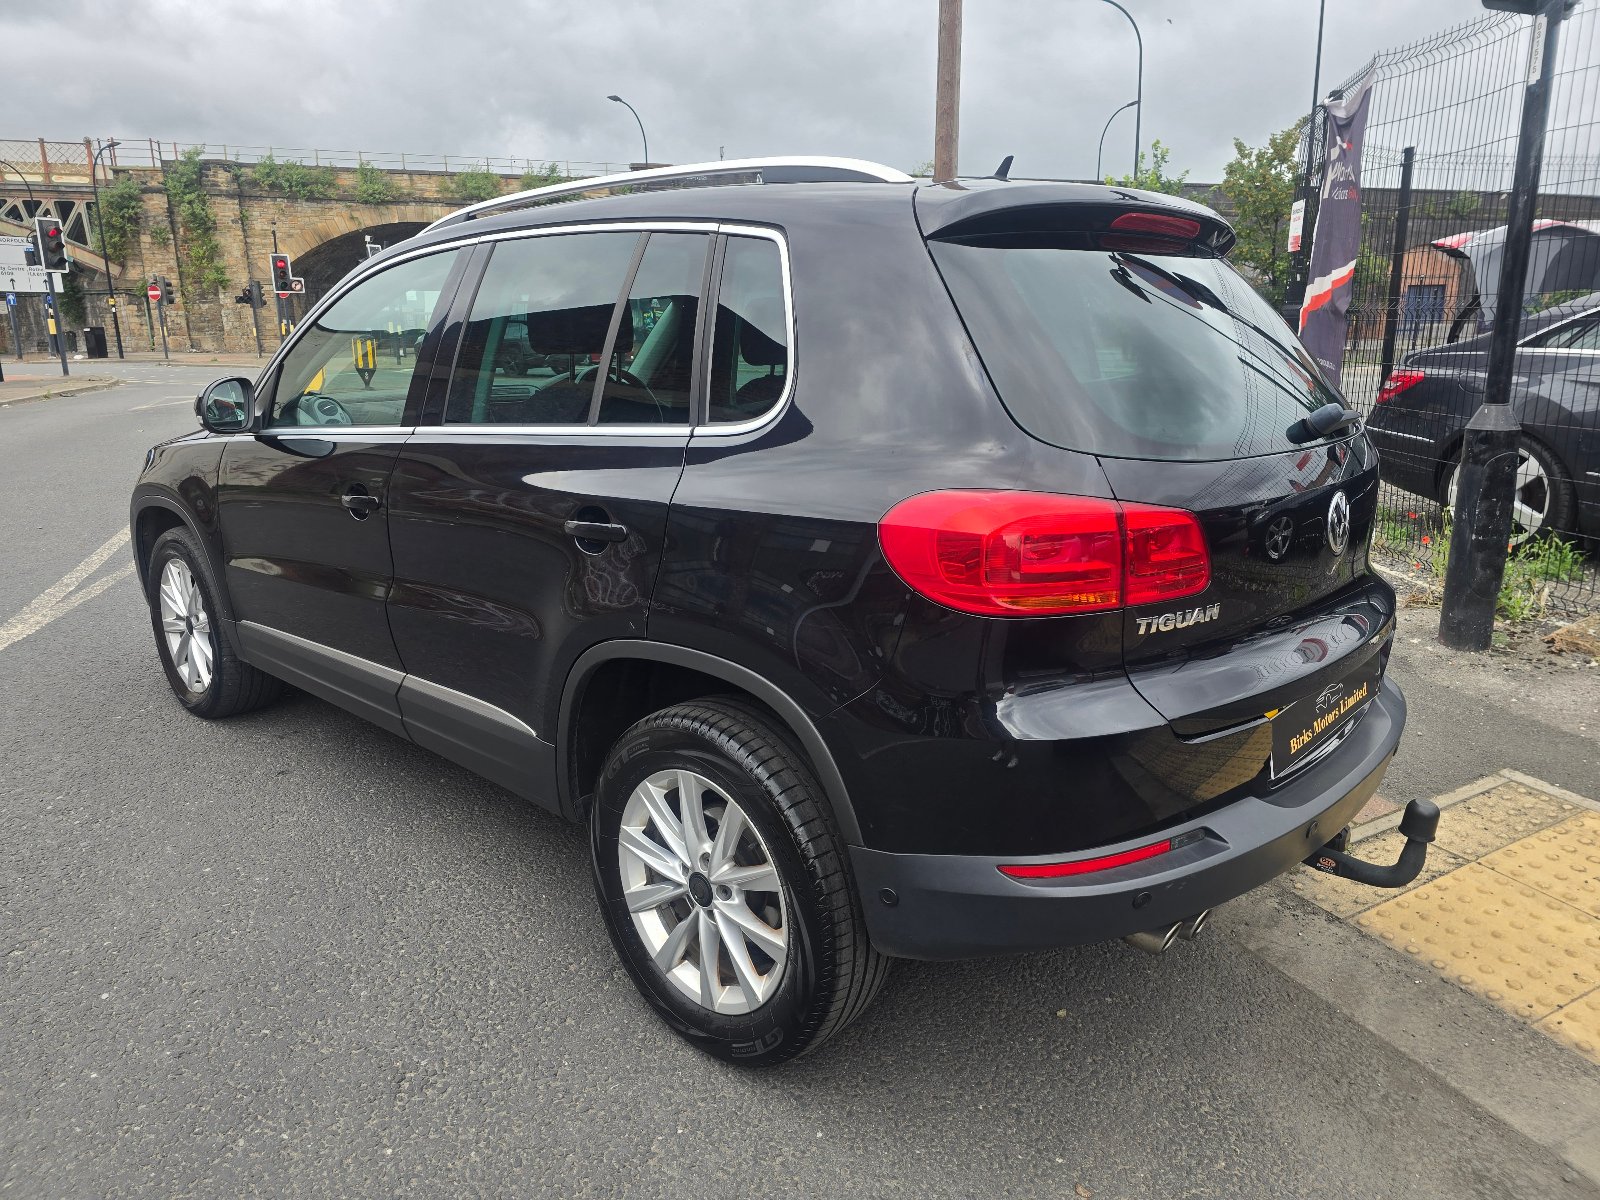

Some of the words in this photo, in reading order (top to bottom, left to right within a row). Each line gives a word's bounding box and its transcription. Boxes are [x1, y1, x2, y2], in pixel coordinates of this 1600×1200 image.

[1135, 602, 1221, 635] TIGUAN
[1289, 729, 1313, 755] Birks
[1313, 707, 1339, 736] Motors
[1339, 682, 1368, 714] Limited
